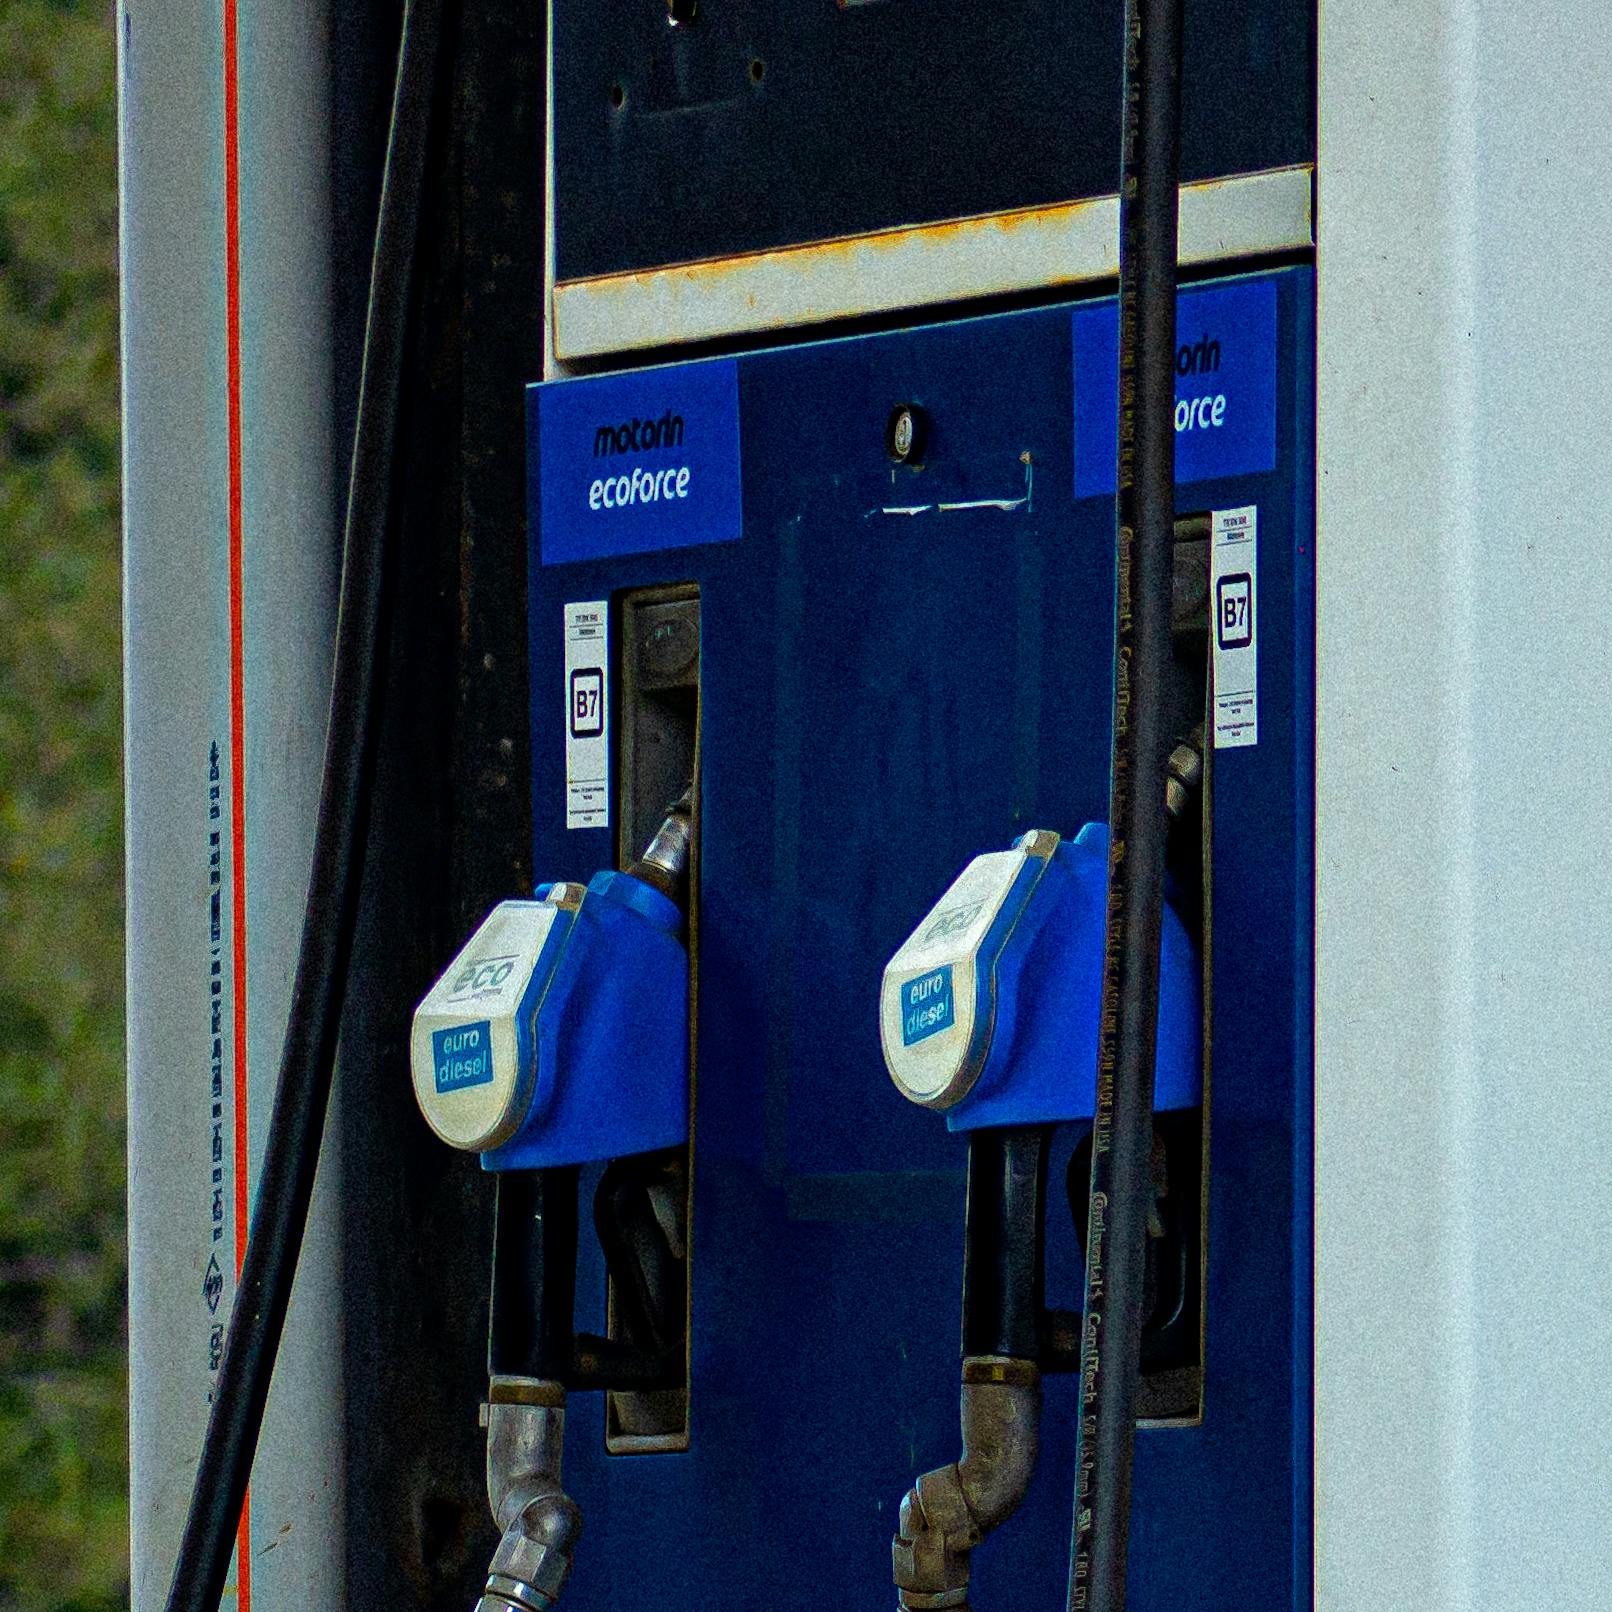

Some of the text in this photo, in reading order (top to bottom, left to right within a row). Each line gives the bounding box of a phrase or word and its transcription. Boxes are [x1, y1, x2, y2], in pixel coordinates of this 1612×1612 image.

[1176, 333, 1220, 376] orin
[1174, 394, 1226, 432] orce
[594, 409, 685, 457] motorin
[588, 467, 691, 510] ecoforce
[1223, 597, 1247, 628] B7
[576, 690, 598, 718] B7
[453, 962, 514, 993] eco
[910, 974, 943, 1005] euro
[907, 995, 949, 1035] diesel
[443, 1030, 479, 1052] euro
[440, 1050, 486, 1082] diesel
